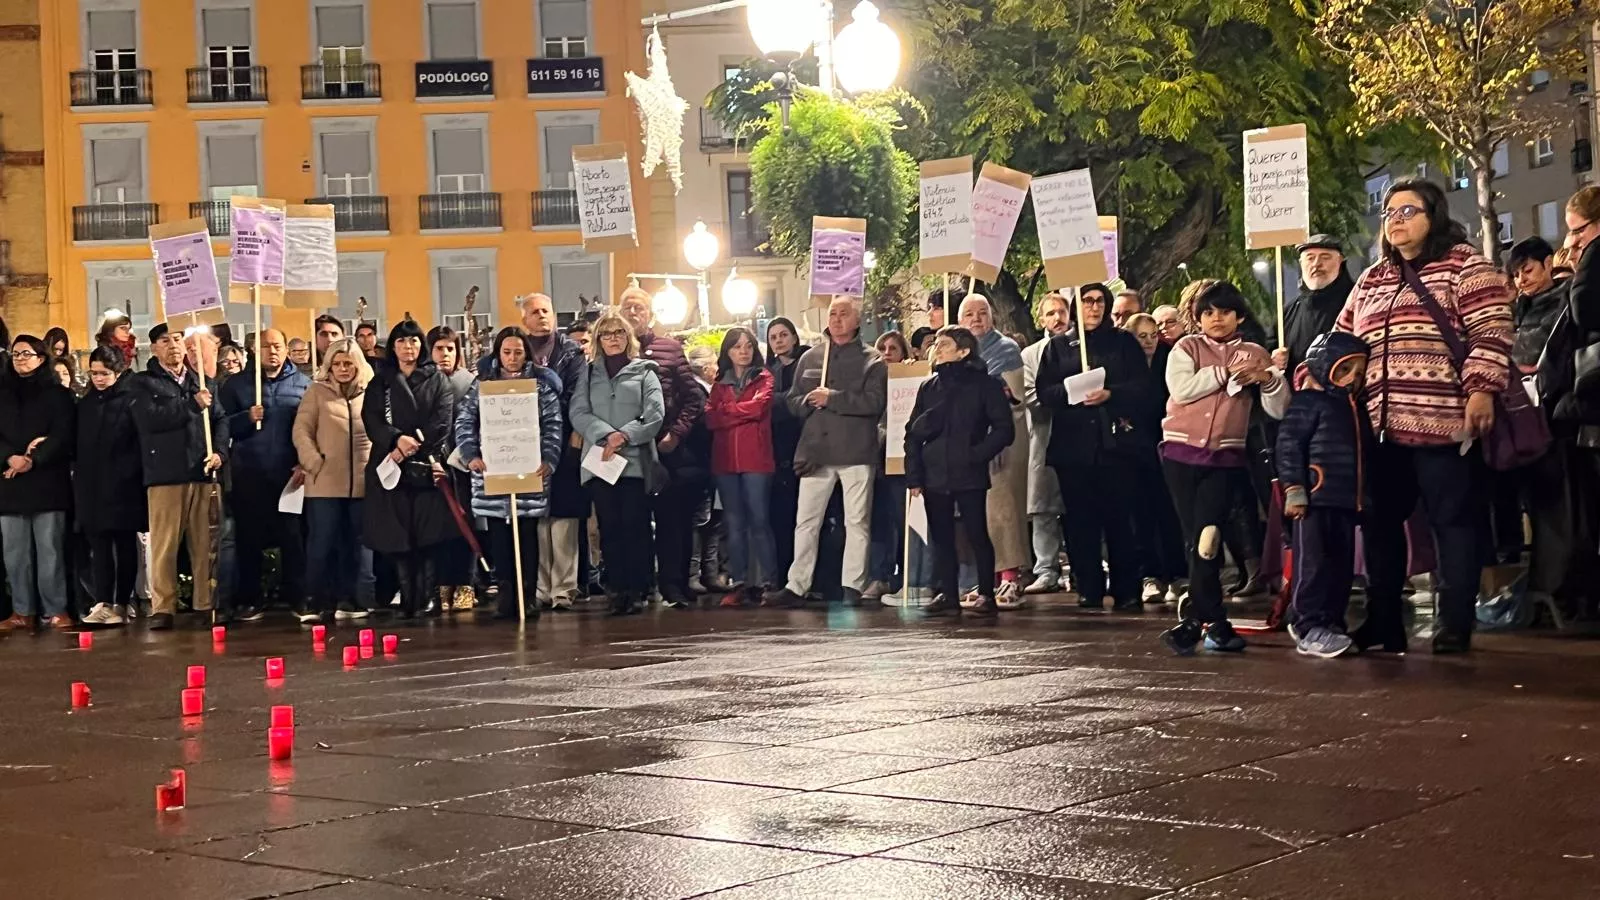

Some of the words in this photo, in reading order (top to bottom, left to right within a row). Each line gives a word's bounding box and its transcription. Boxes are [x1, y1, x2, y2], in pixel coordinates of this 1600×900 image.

[419, 70, 488, 83] PODÓLOGO
[531, 70, 550, 80] 611
[553, 69, 567, 80] 59
[570, 68, 583, 79] 16
[586, 68, 600, 78] 16
[1248, 148, 1288, 165] Querer
[582, 166, 609, 180] Aborto
[1248, 194, 1262, 206] NO
[1261, 204, 1295, 219] Querer
